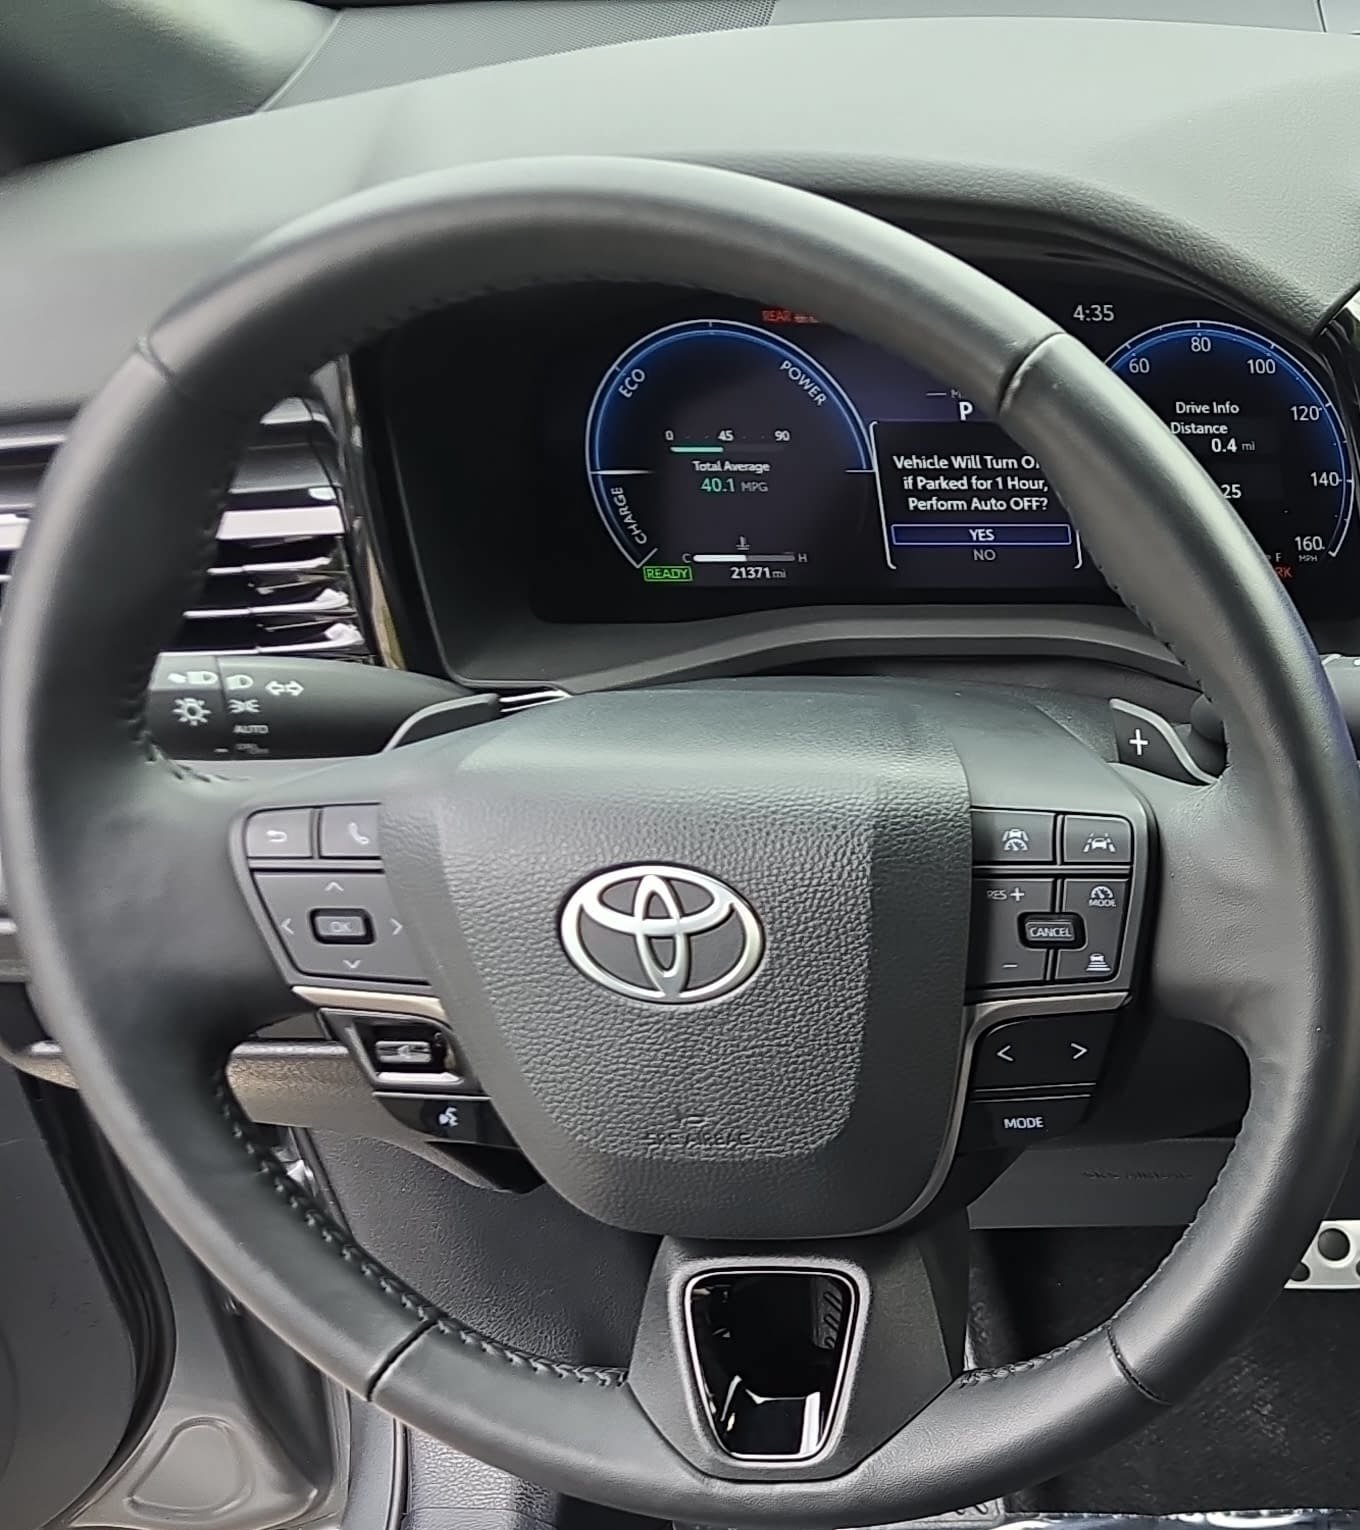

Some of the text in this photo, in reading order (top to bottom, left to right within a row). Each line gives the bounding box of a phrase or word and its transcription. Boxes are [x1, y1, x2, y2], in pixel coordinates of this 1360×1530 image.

[1073, 304, 1115, 323] 4:35
[1191, 337, 1212, 353] 80
[1128, 357, 1151, 375] 60
[1246, 357, 1277, 376] 100
[618, 368, 646, 399] ECO
[779, 360, 828, 406] POWER
[959, 401, 973, 421] P
[1175, 401, 1240, 415] Drive Info
[1290, 404, 1318, 422] 120
[665, 430, 790, 442] 0 45 90
[1170, 421, 1228, 436] Distance
[1211, 438, 1256, 453] 0.4 mi
[692, 461, 771, 474] Total Average
[893, 455, 949, 469] Vehicle
[951, 455, 981, 469] Will
[983, 455, 1018, 469] Turn
[701, 478, 769, 493] 40.1 MPG
[903, 476, 1049, 492] if Parked for 1 Hour,
[1310, 471, 1339, 487] 140
[908, 497, 1048, 511] Perform Auto OFF?
[611, 486, 648, 545] CHARGE
[969, 529, 995, 541] YES
[1294, 536, 1323, 551] 160
[682, 553, 807, 564] C H
[973, 549, 996, 561] NO
[647, 568, 690, 580] READY
[730, 567, 787, 580] 21371 mi
[1088, 898, 1117, 908] MODE
[1029, 926, 1072, 938] CANCEL
[1004, 1117, 1044, 1129] MODE
